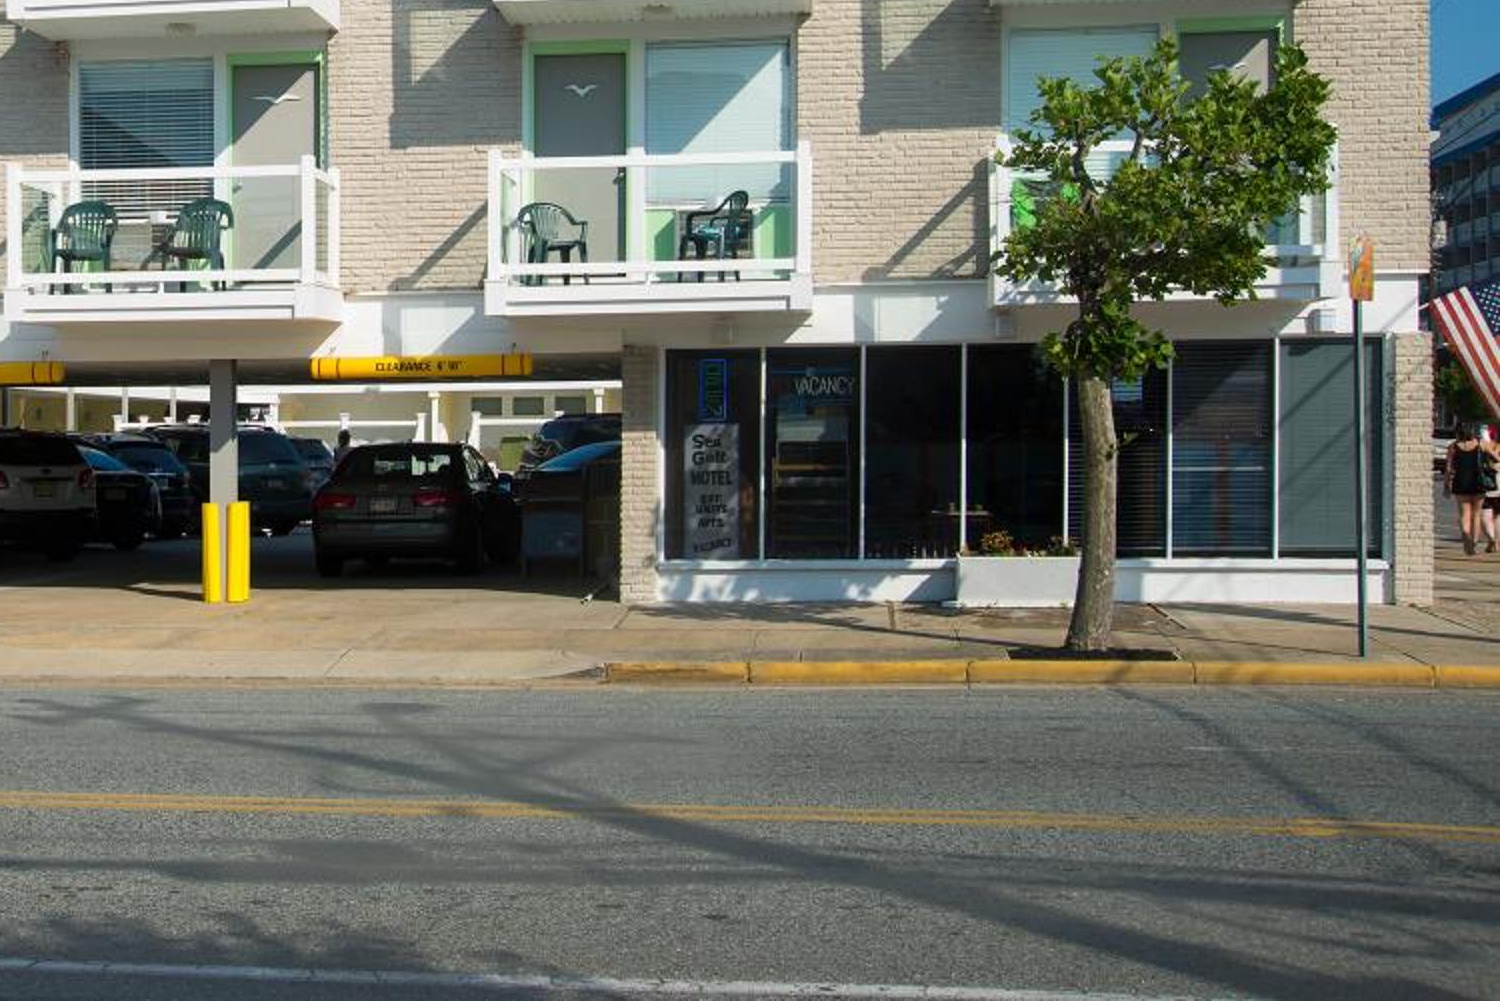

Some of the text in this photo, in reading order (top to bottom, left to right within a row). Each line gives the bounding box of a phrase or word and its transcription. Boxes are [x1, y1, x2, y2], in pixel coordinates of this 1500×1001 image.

[375, 360, 432, 372] CLEARANCE
[794, 375, 854, 395] VACANCY
[692, 434, 721, 449] Sea
[691, 471, 732, 485] MOTEL
